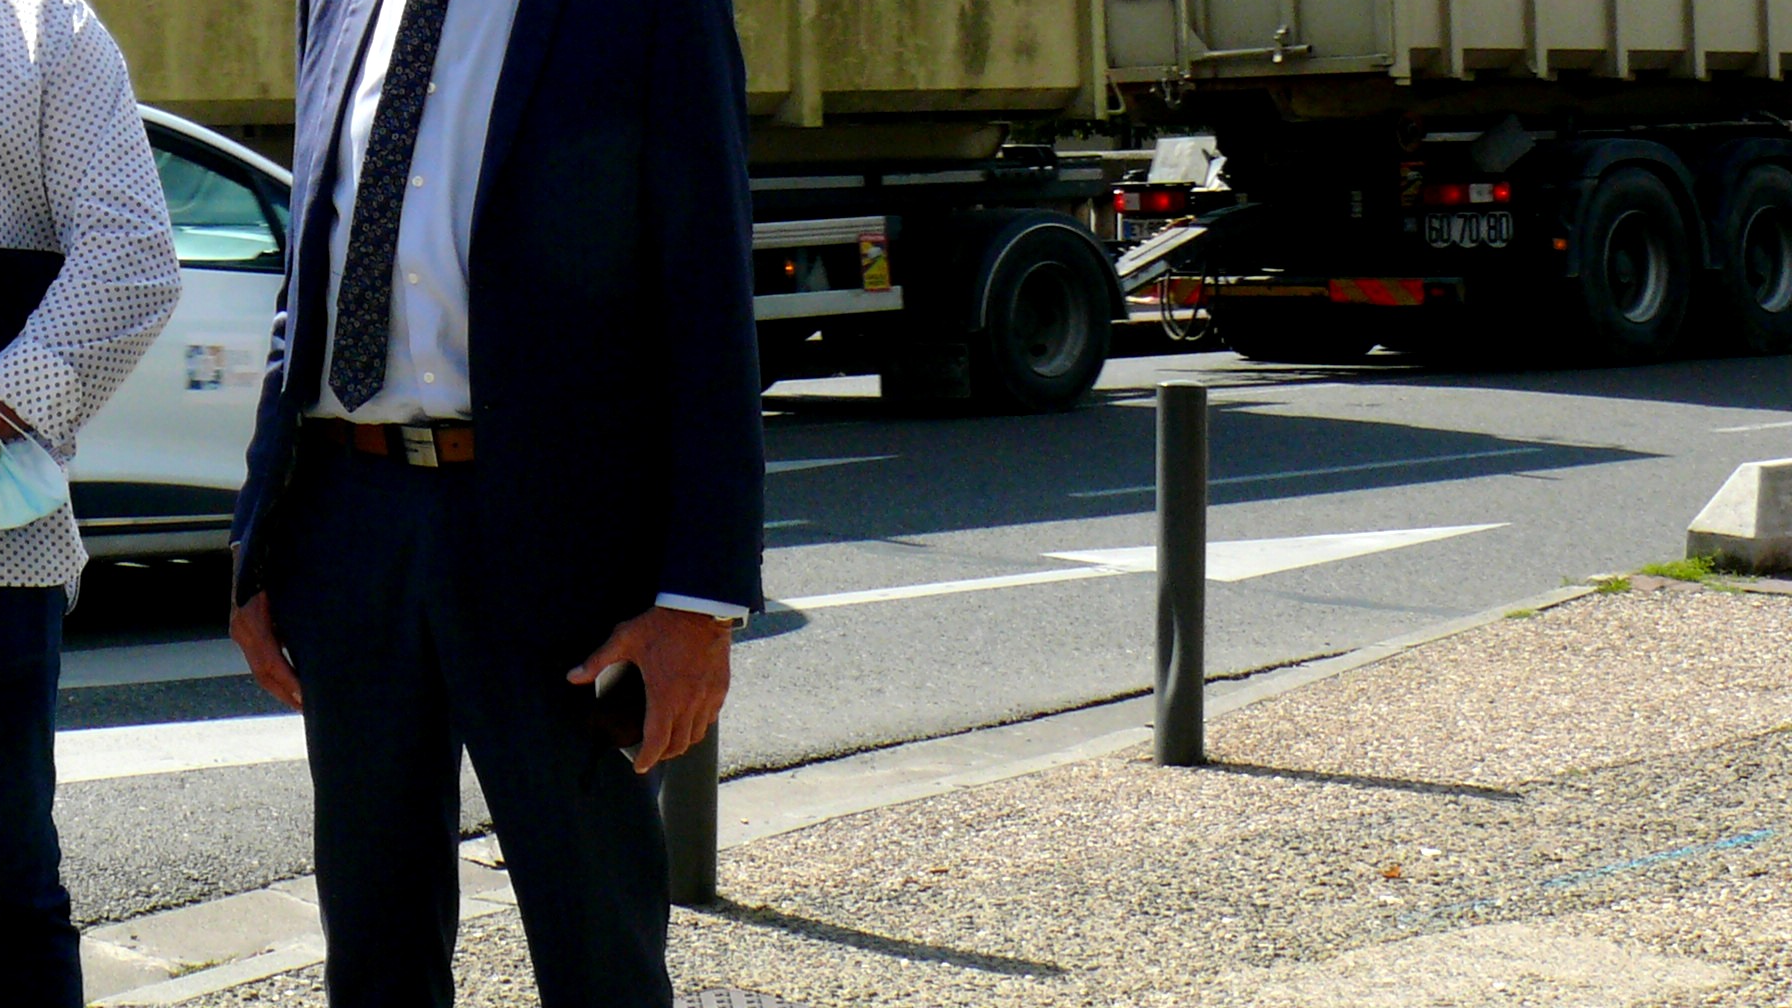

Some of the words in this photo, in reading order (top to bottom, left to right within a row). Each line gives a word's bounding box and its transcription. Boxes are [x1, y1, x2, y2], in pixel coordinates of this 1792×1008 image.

[1428, 214, 1451, 244] 60
[1456, 213, 1480, 244] 70
[1487, 213, 1510, 244] 80
